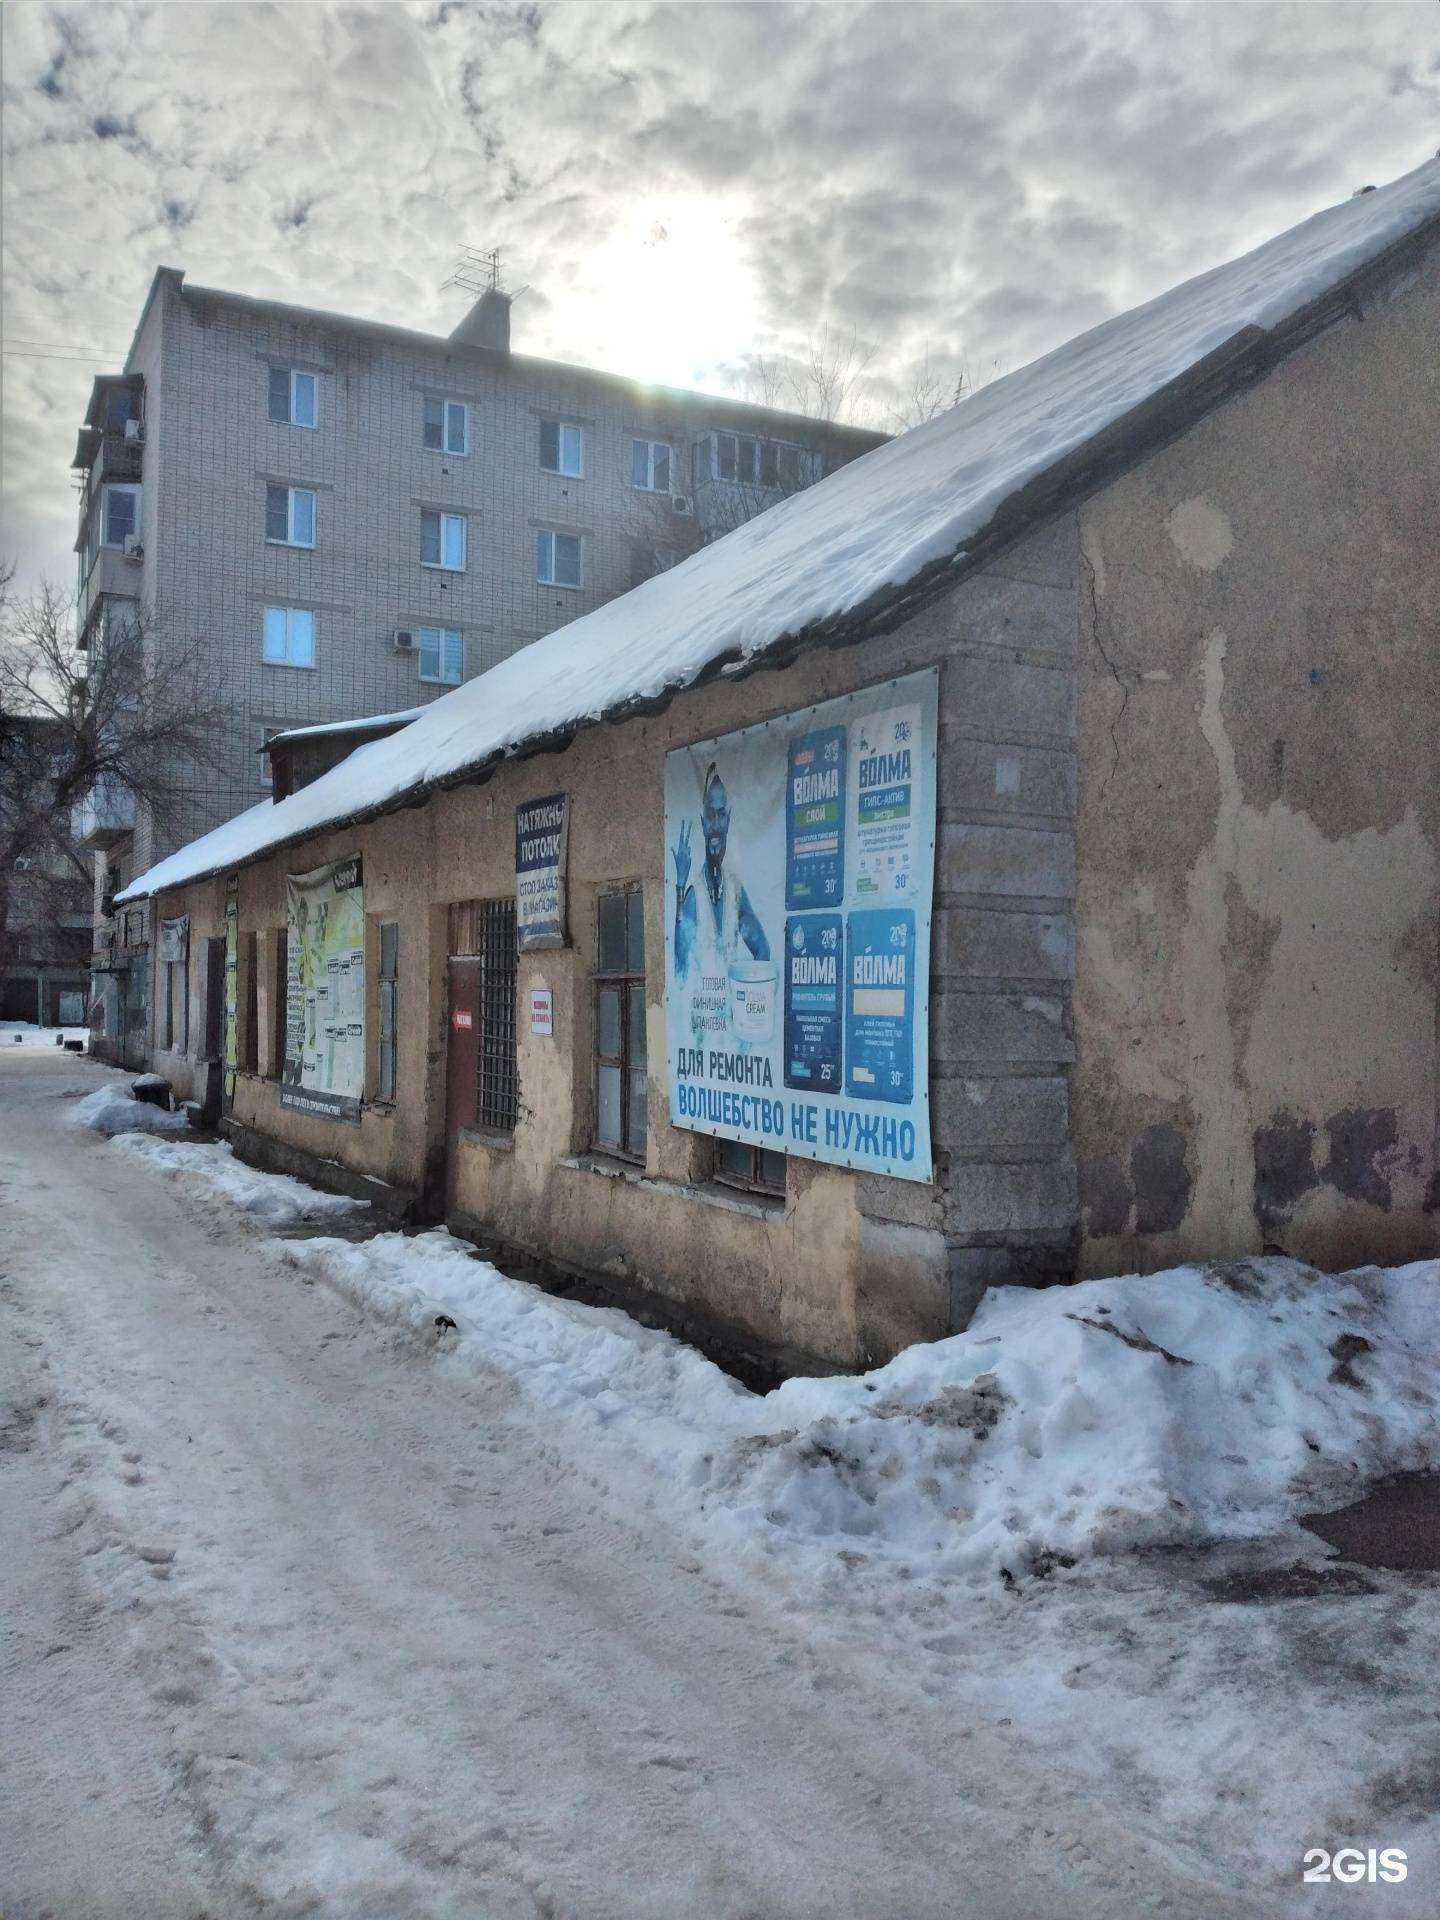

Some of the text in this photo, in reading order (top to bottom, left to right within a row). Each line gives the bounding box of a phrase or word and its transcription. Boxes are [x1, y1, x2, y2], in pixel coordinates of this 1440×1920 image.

[794, 769, 839, 805] ВОЛМА
[859, 750, 911, 788] ВОЛМА
[792, 955, 836, 984] ВОЛМА
[854, 955, 905, 984] ВОЛМА
[677, 1048, 703, 1080] ДЛЯ
[710, 1052, 773, 1088] РЕМОНТА
[679, 1084, 916, 1162] ВОЛШЕБСТВО НЕ НУЖНО
